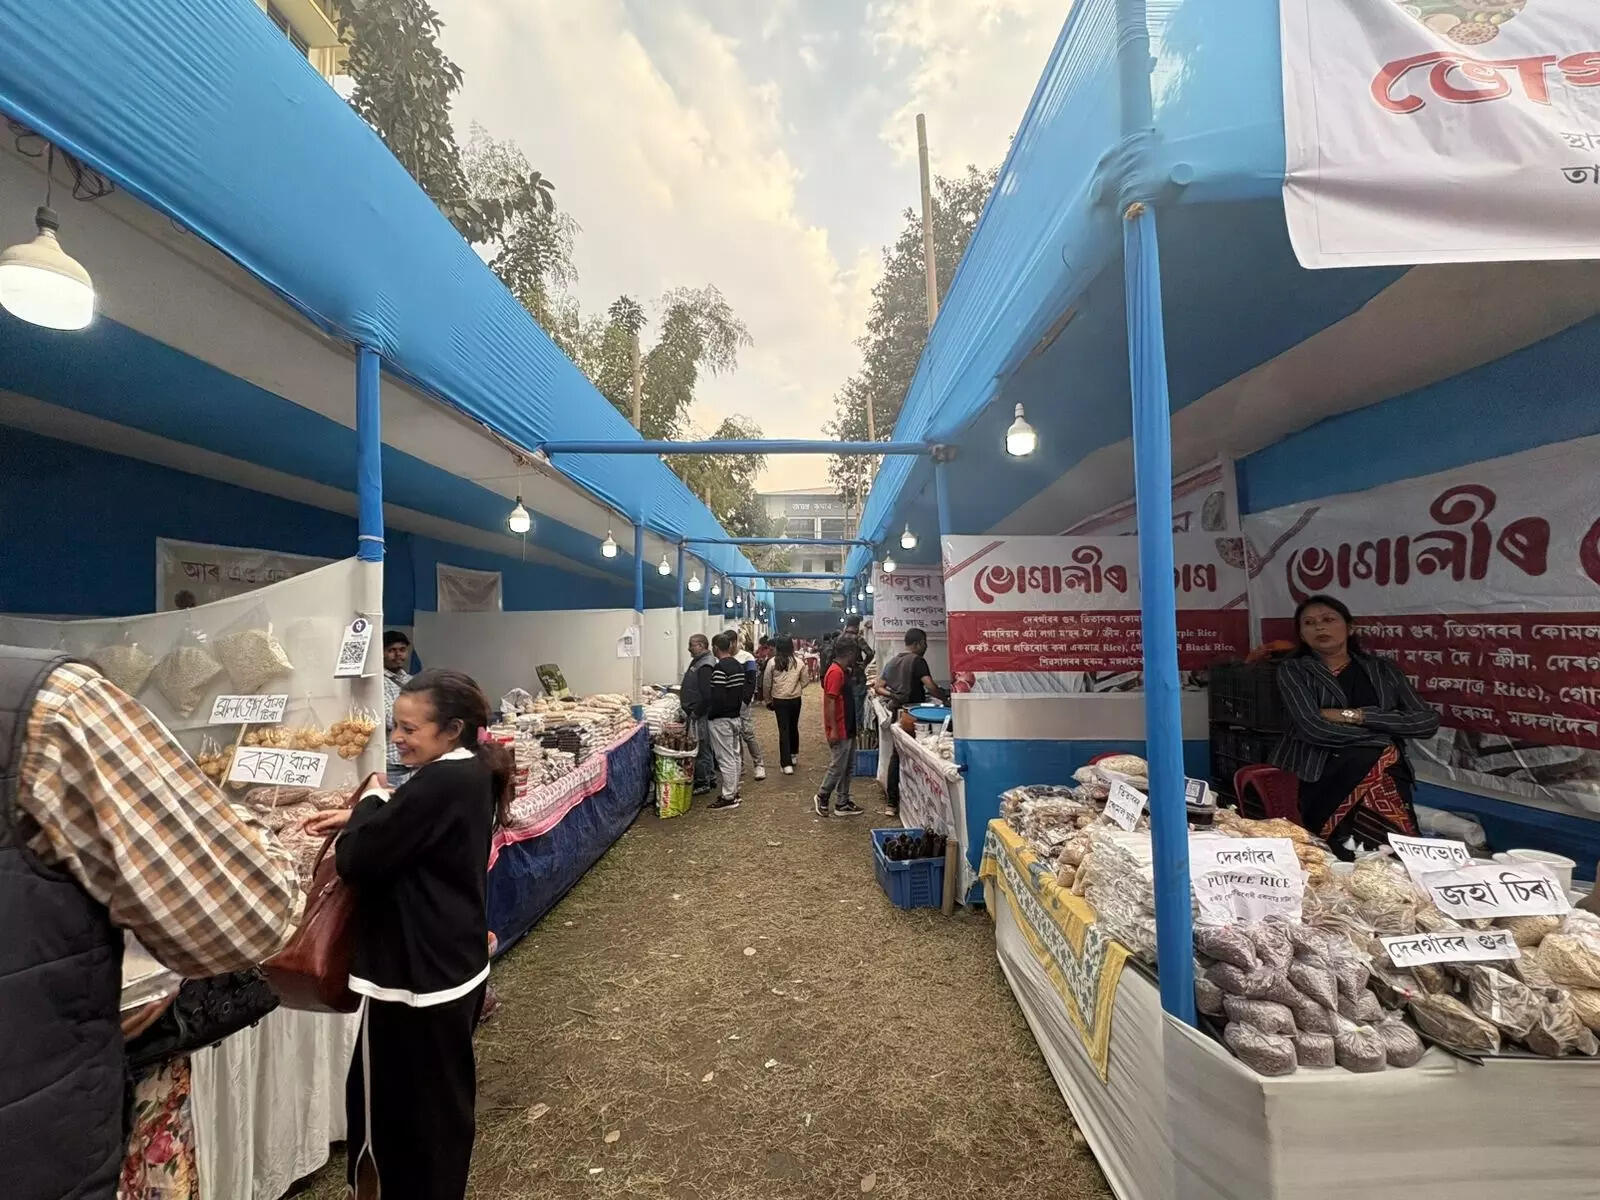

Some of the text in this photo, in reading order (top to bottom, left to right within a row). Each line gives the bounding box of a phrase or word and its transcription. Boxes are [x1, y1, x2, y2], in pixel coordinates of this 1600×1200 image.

[1286, 484, 1550, 604] ভোগালীৰ
[973, 545, 1128, 604] ভোগালীৰ
[1197, 629, 1217, 637] Rice
[1186, 643, 1212, 651] Black
[1450, 648, 1471, 667] দৈ
[1493, 681, 1551, 703] Rice),
[1216, 847, 1275, 865] দেৰগাঁৱৰ
[1260, 875, 1291, 889] RICE
[1434, 872, 1558, 907] জহা চিৰা
[1475, 933, 1508, 951] গুৰ
